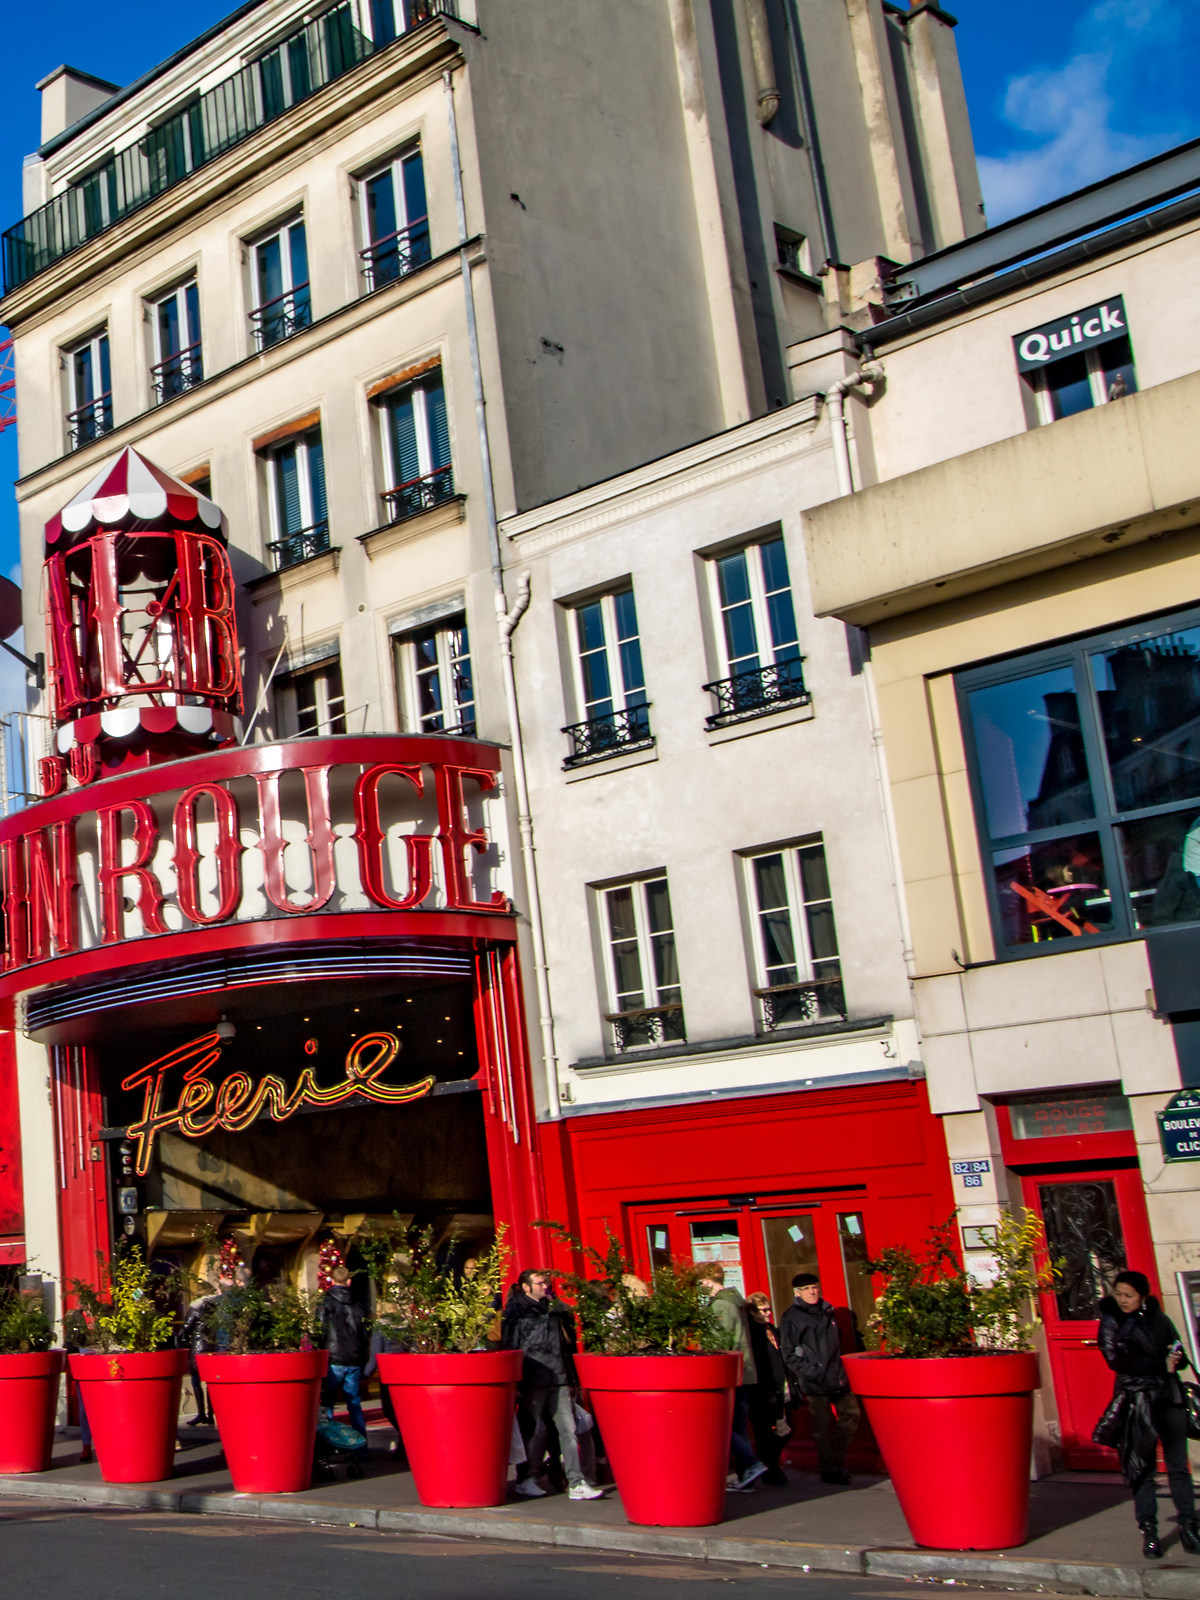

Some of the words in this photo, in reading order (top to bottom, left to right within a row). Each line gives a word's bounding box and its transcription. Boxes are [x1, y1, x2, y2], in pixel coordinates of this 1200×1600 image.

[1019, 305, 1125, 361] Quick
[96, 763, 511, 943] ROUGE
[122, 1030, 436, 1176] Féerie
[1176, 1140, 1200, 1152] CLIC
[954, 1162, 969, 1173] 82
[972, 1161, 988, 1172] 84
[965, 1176, 980, 1186] 86
